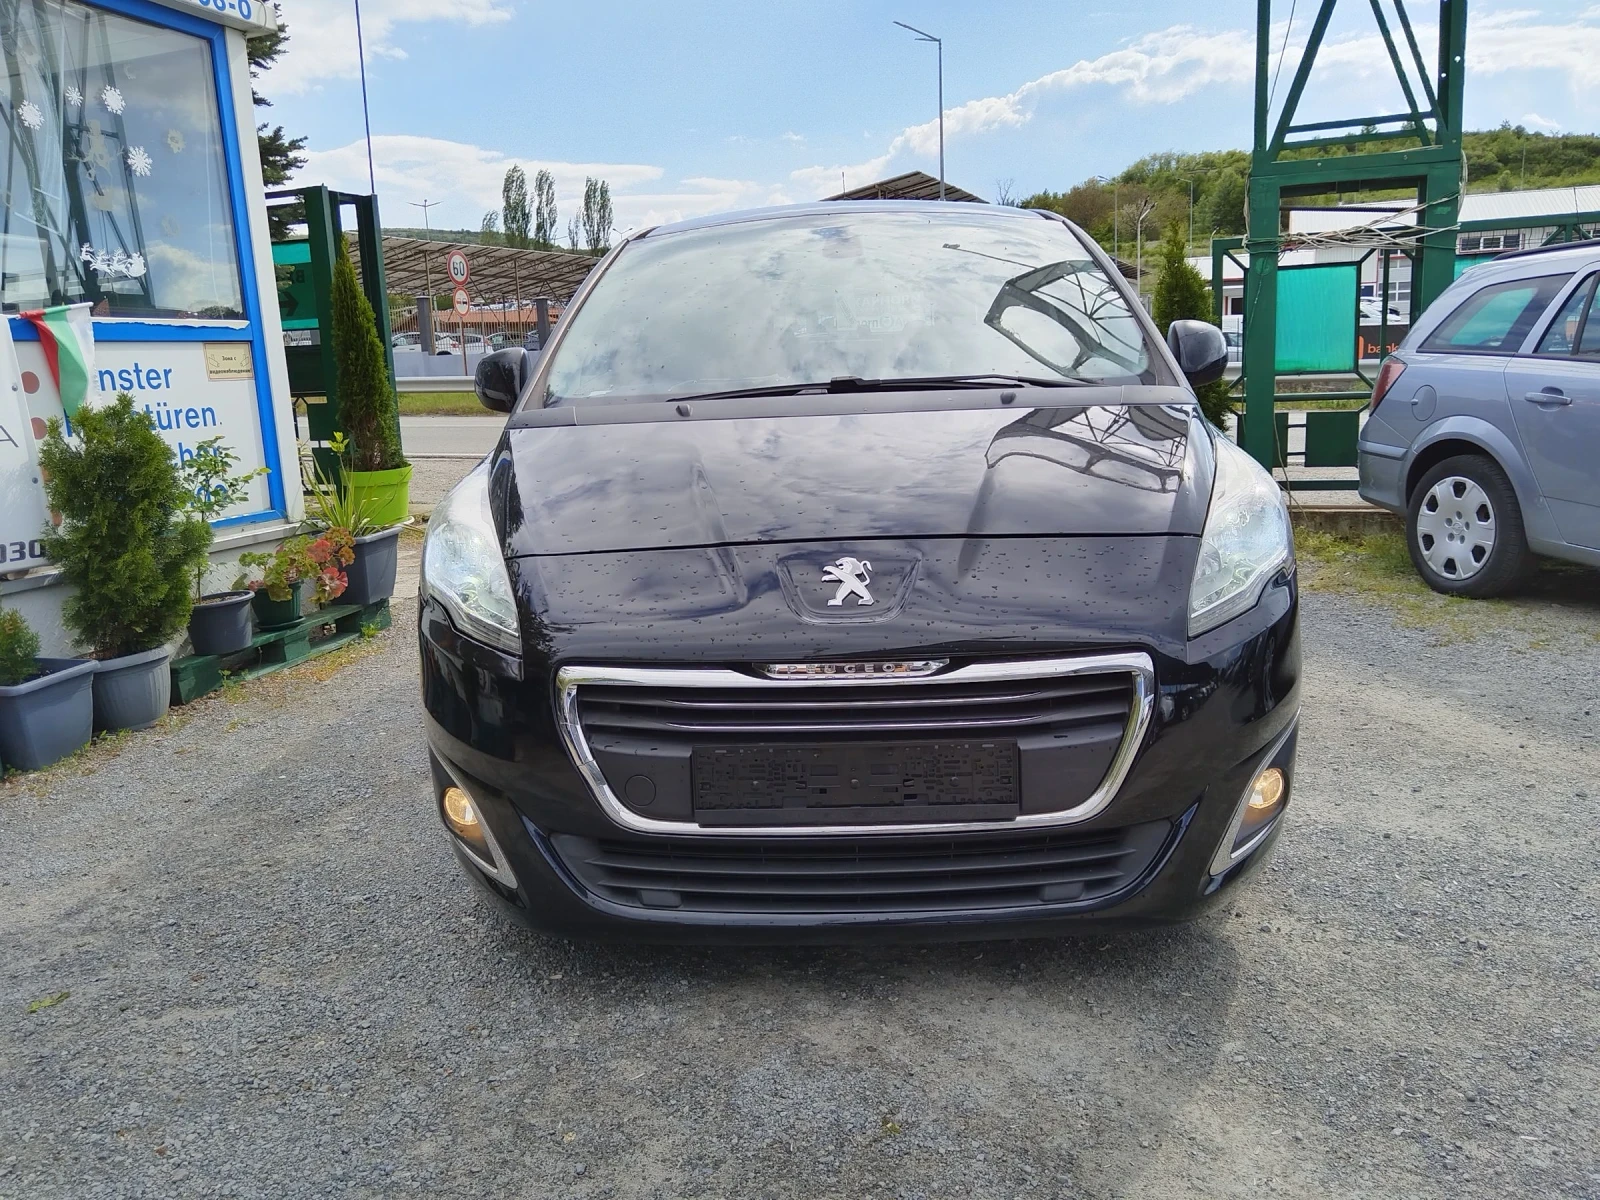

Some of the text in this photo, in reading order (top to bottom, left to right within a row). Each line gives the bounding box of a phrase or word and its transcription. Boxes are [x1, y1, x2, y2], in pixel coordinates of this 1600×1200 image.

[453, 261, 465, 276] 60
[98, 362, 173, 392] nster
[787, 662, 914, 674] PEUGEOT
